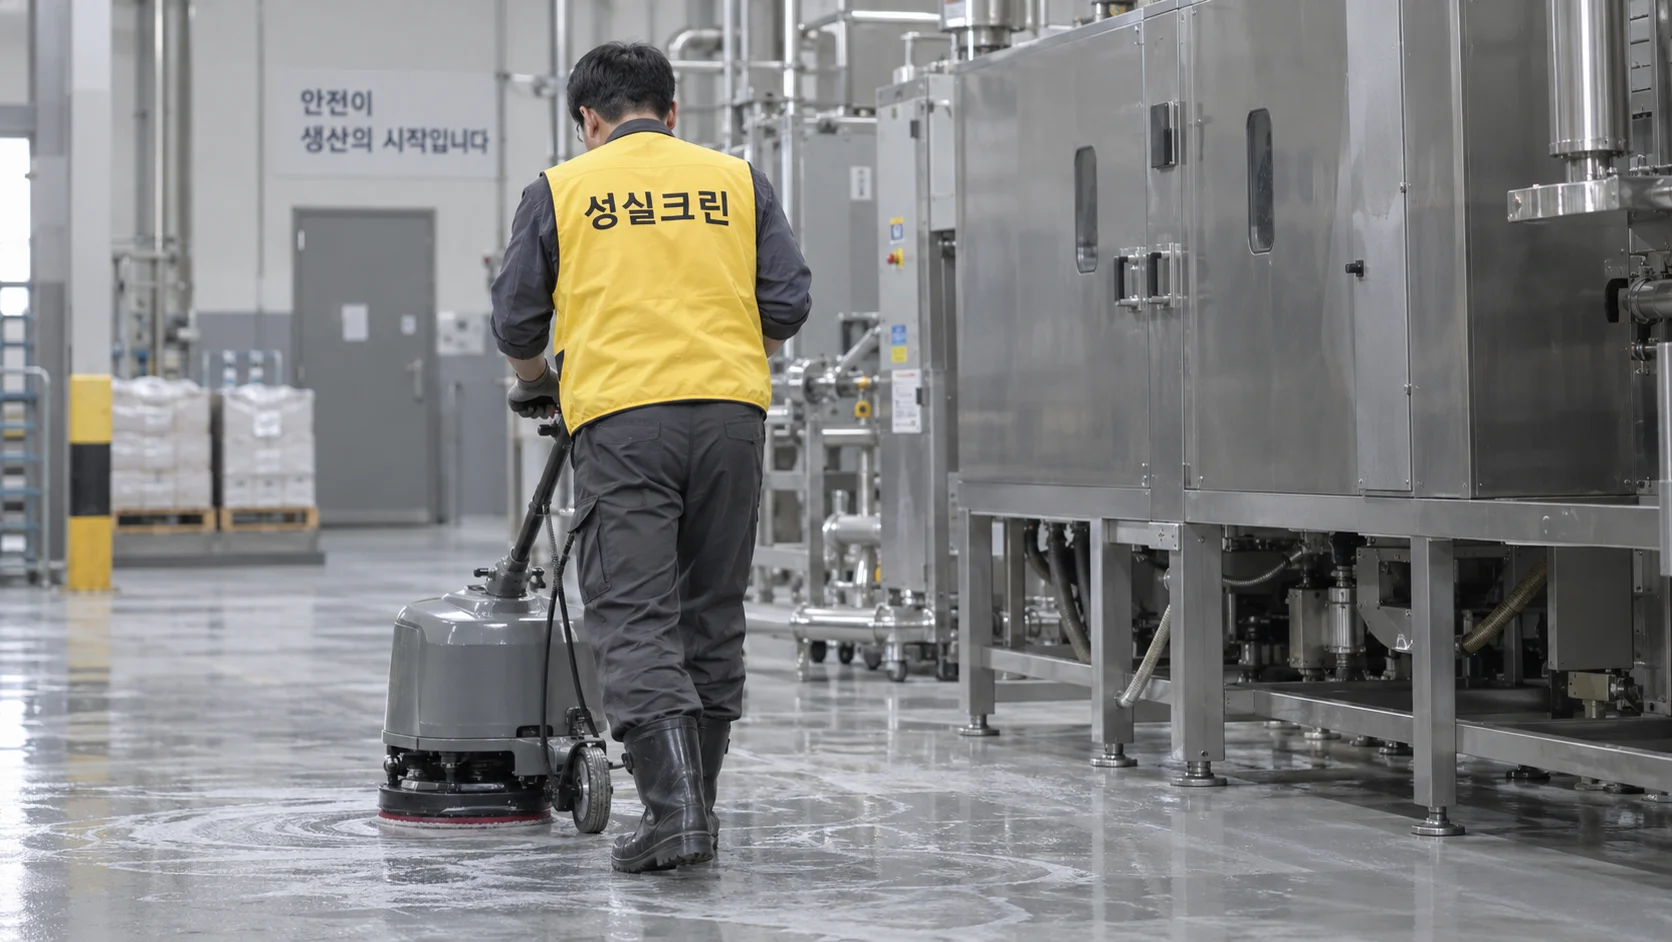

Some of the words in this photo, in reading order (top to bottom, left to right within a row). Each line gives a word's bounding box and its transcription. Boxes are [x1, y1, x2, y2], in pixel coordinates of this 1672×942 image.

[300, 88, 373, 117] 안전이
[301, 125, 373, 153] 생산의
[382, 127, 489, 154] 시작입니다
[584, 190, 729, 230] 성실크린
